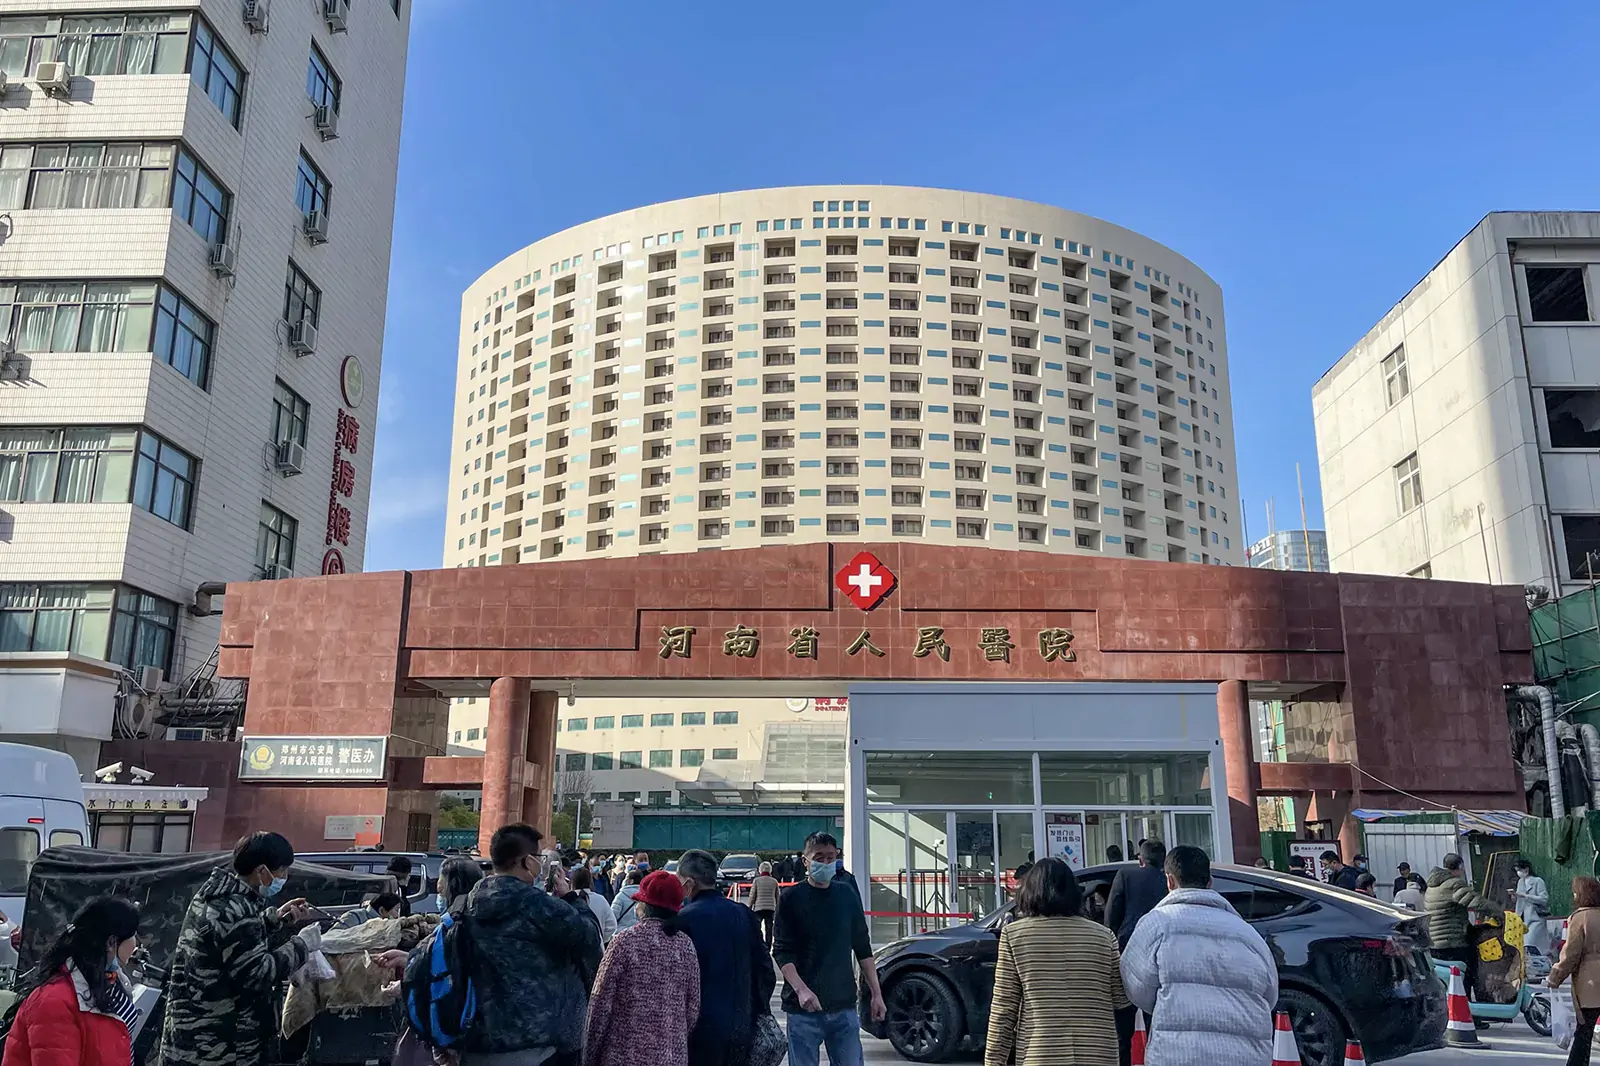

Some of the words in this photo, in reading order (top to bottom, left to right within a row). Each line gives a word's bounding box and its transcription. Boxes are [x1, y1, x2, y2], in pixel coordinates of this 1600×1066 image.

[333, 414, 360, 546] 病房楼
[659, 624, 1076, 662] 河南省人民醫院
[281, 745, 334, 755] 郑州市公安局
[338, 747, 375, 764] 警医办
[280, 756, 333, 766] 河南省人民医院
